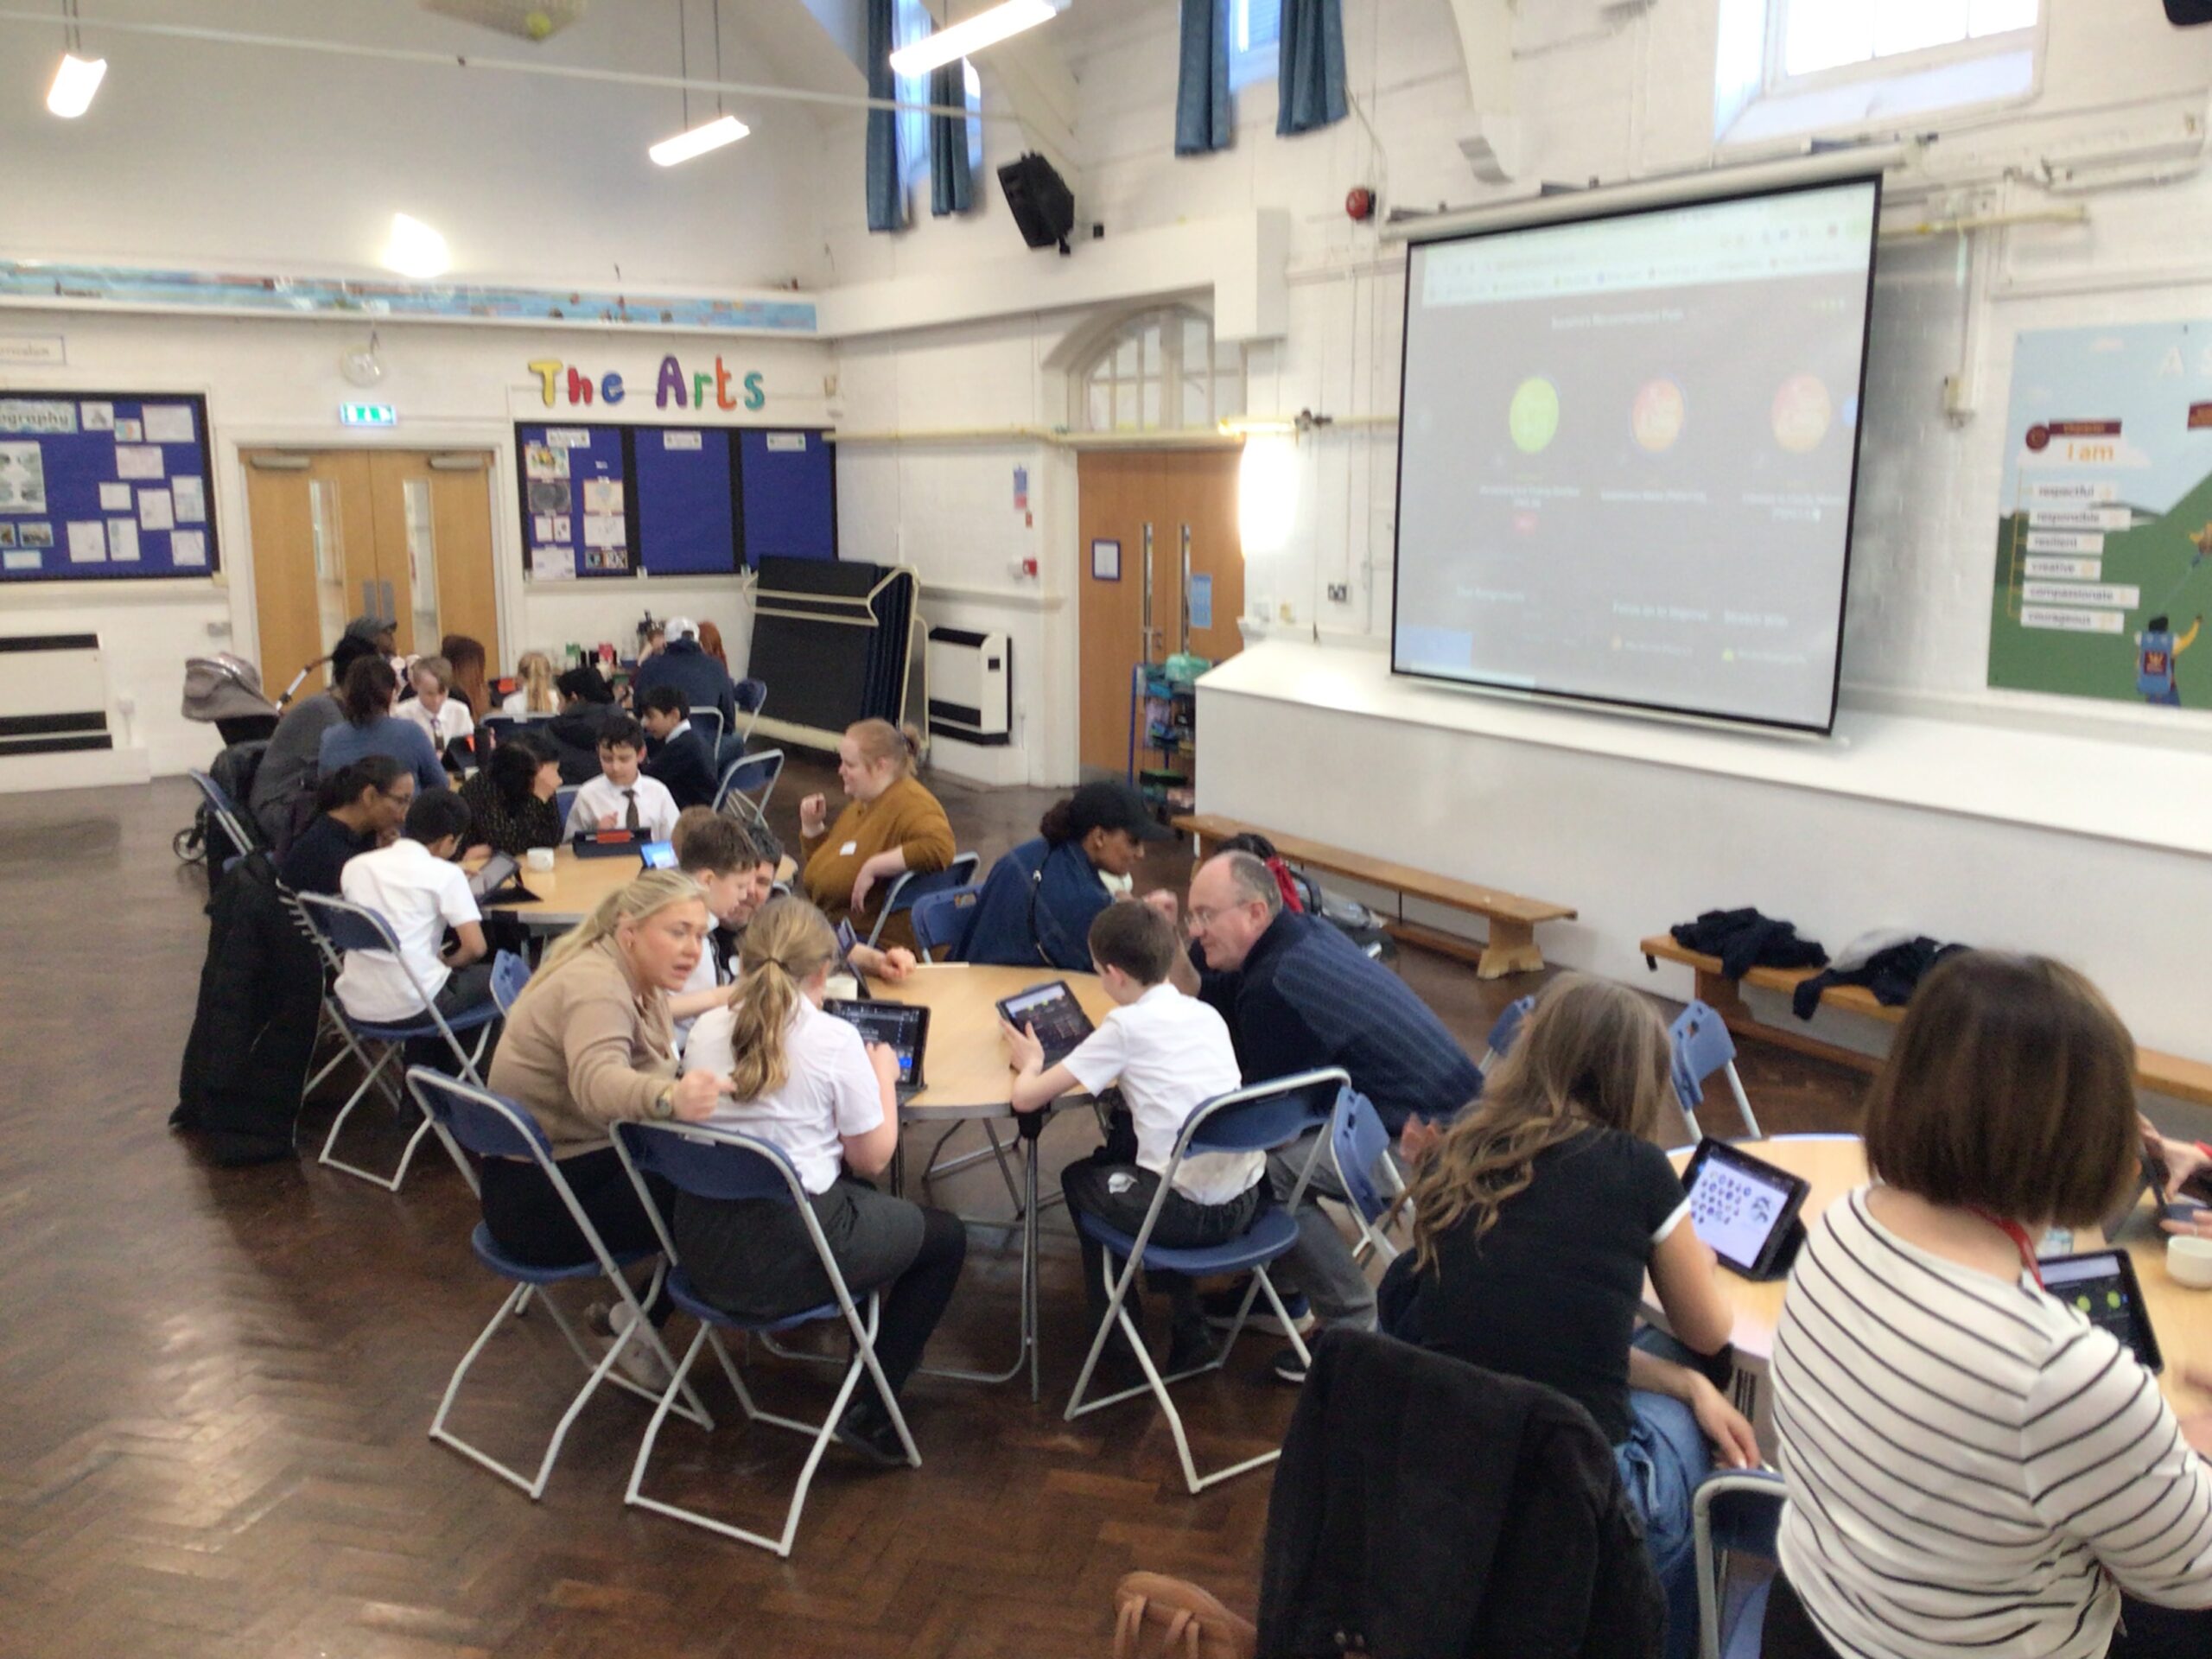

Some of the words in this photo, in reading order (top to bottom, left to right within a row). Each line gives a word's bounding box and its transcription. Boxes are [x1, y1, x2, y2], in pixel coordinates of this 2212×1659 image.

[528, 359, 625, 408] The
[656, 353, 766, 410] Arts
[2067, 442, 2074, 461] I
[2079, 444, 2114, 462] am
